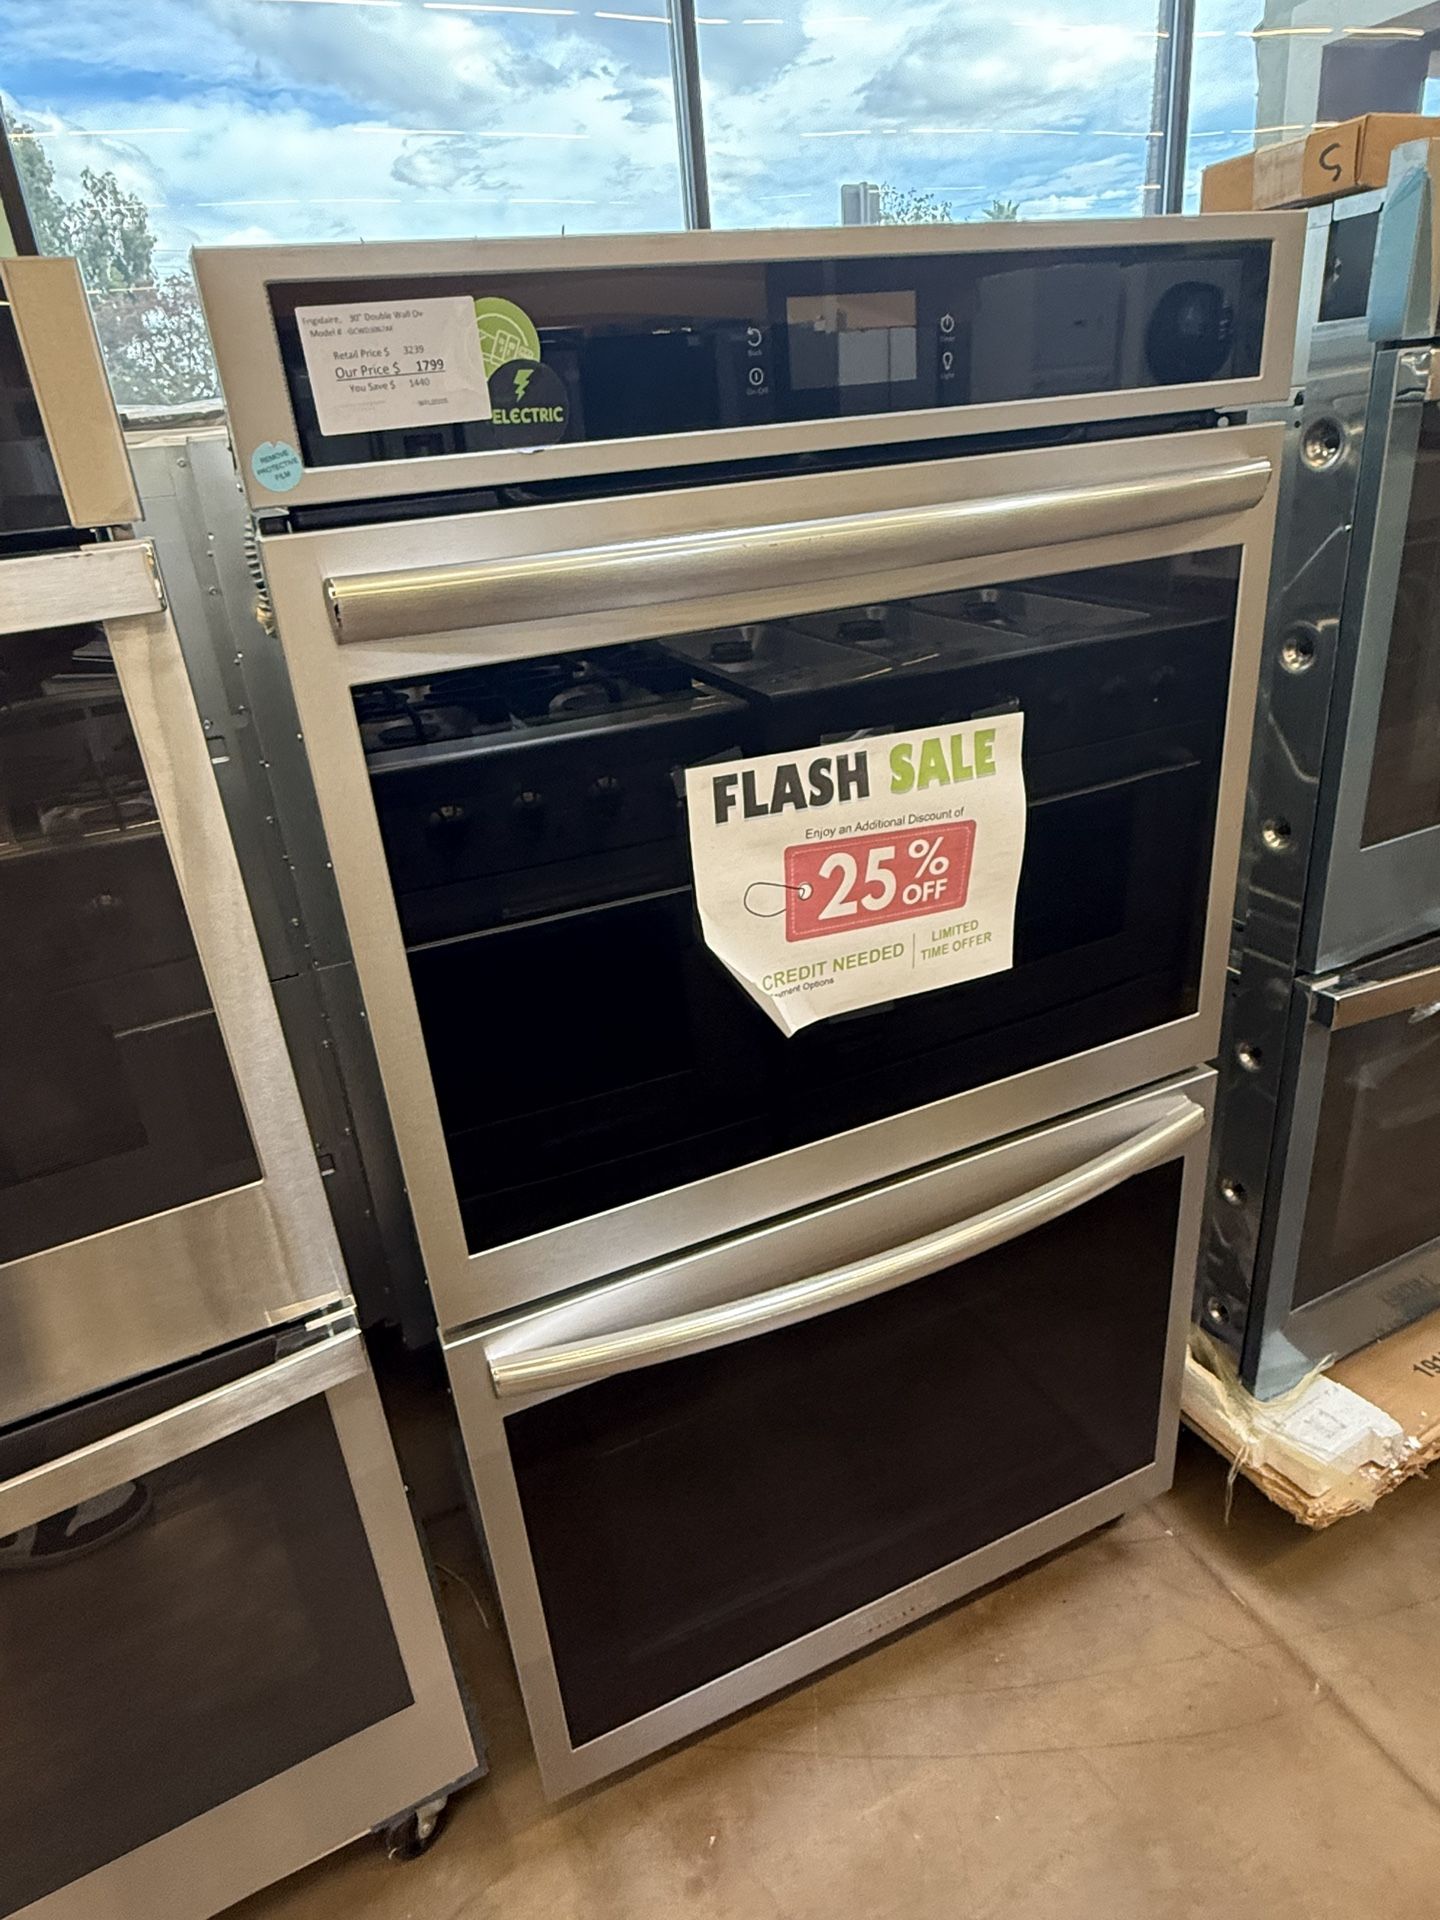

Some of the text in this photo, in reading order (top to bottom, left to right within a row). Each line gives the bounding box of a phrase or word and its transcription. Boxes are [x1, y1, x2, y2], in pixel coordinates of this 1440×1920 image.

[364, 311, 392, 321] Double
[393, 310, 411, 319] Wall
[310, 328, 335, 338] Model
[333, 345, 425, 360] Retail Price $ 3239
[335, 358, 445, 380] Our Price $ 1799
[349, 377, 431, 393] You Save $ 1440
[492, 406, 565, 425] ELECTRIC
[260, 449, 289, 463] REMOVE
[713, 728, 997, 826] FLASH SALE
[805, 806, 965, 840] Enjoy an Additional Discount of
[817, 836, 950, 921] 25 %
[902, 878, 949, 905] OFF
[932, 919, 979, 942] LIMITED
[921, 932, 992, 961] TIME OFFER
[762, 943, 905, 992] CREDIT NEEDED
[803, 977, 834, 992] Options
